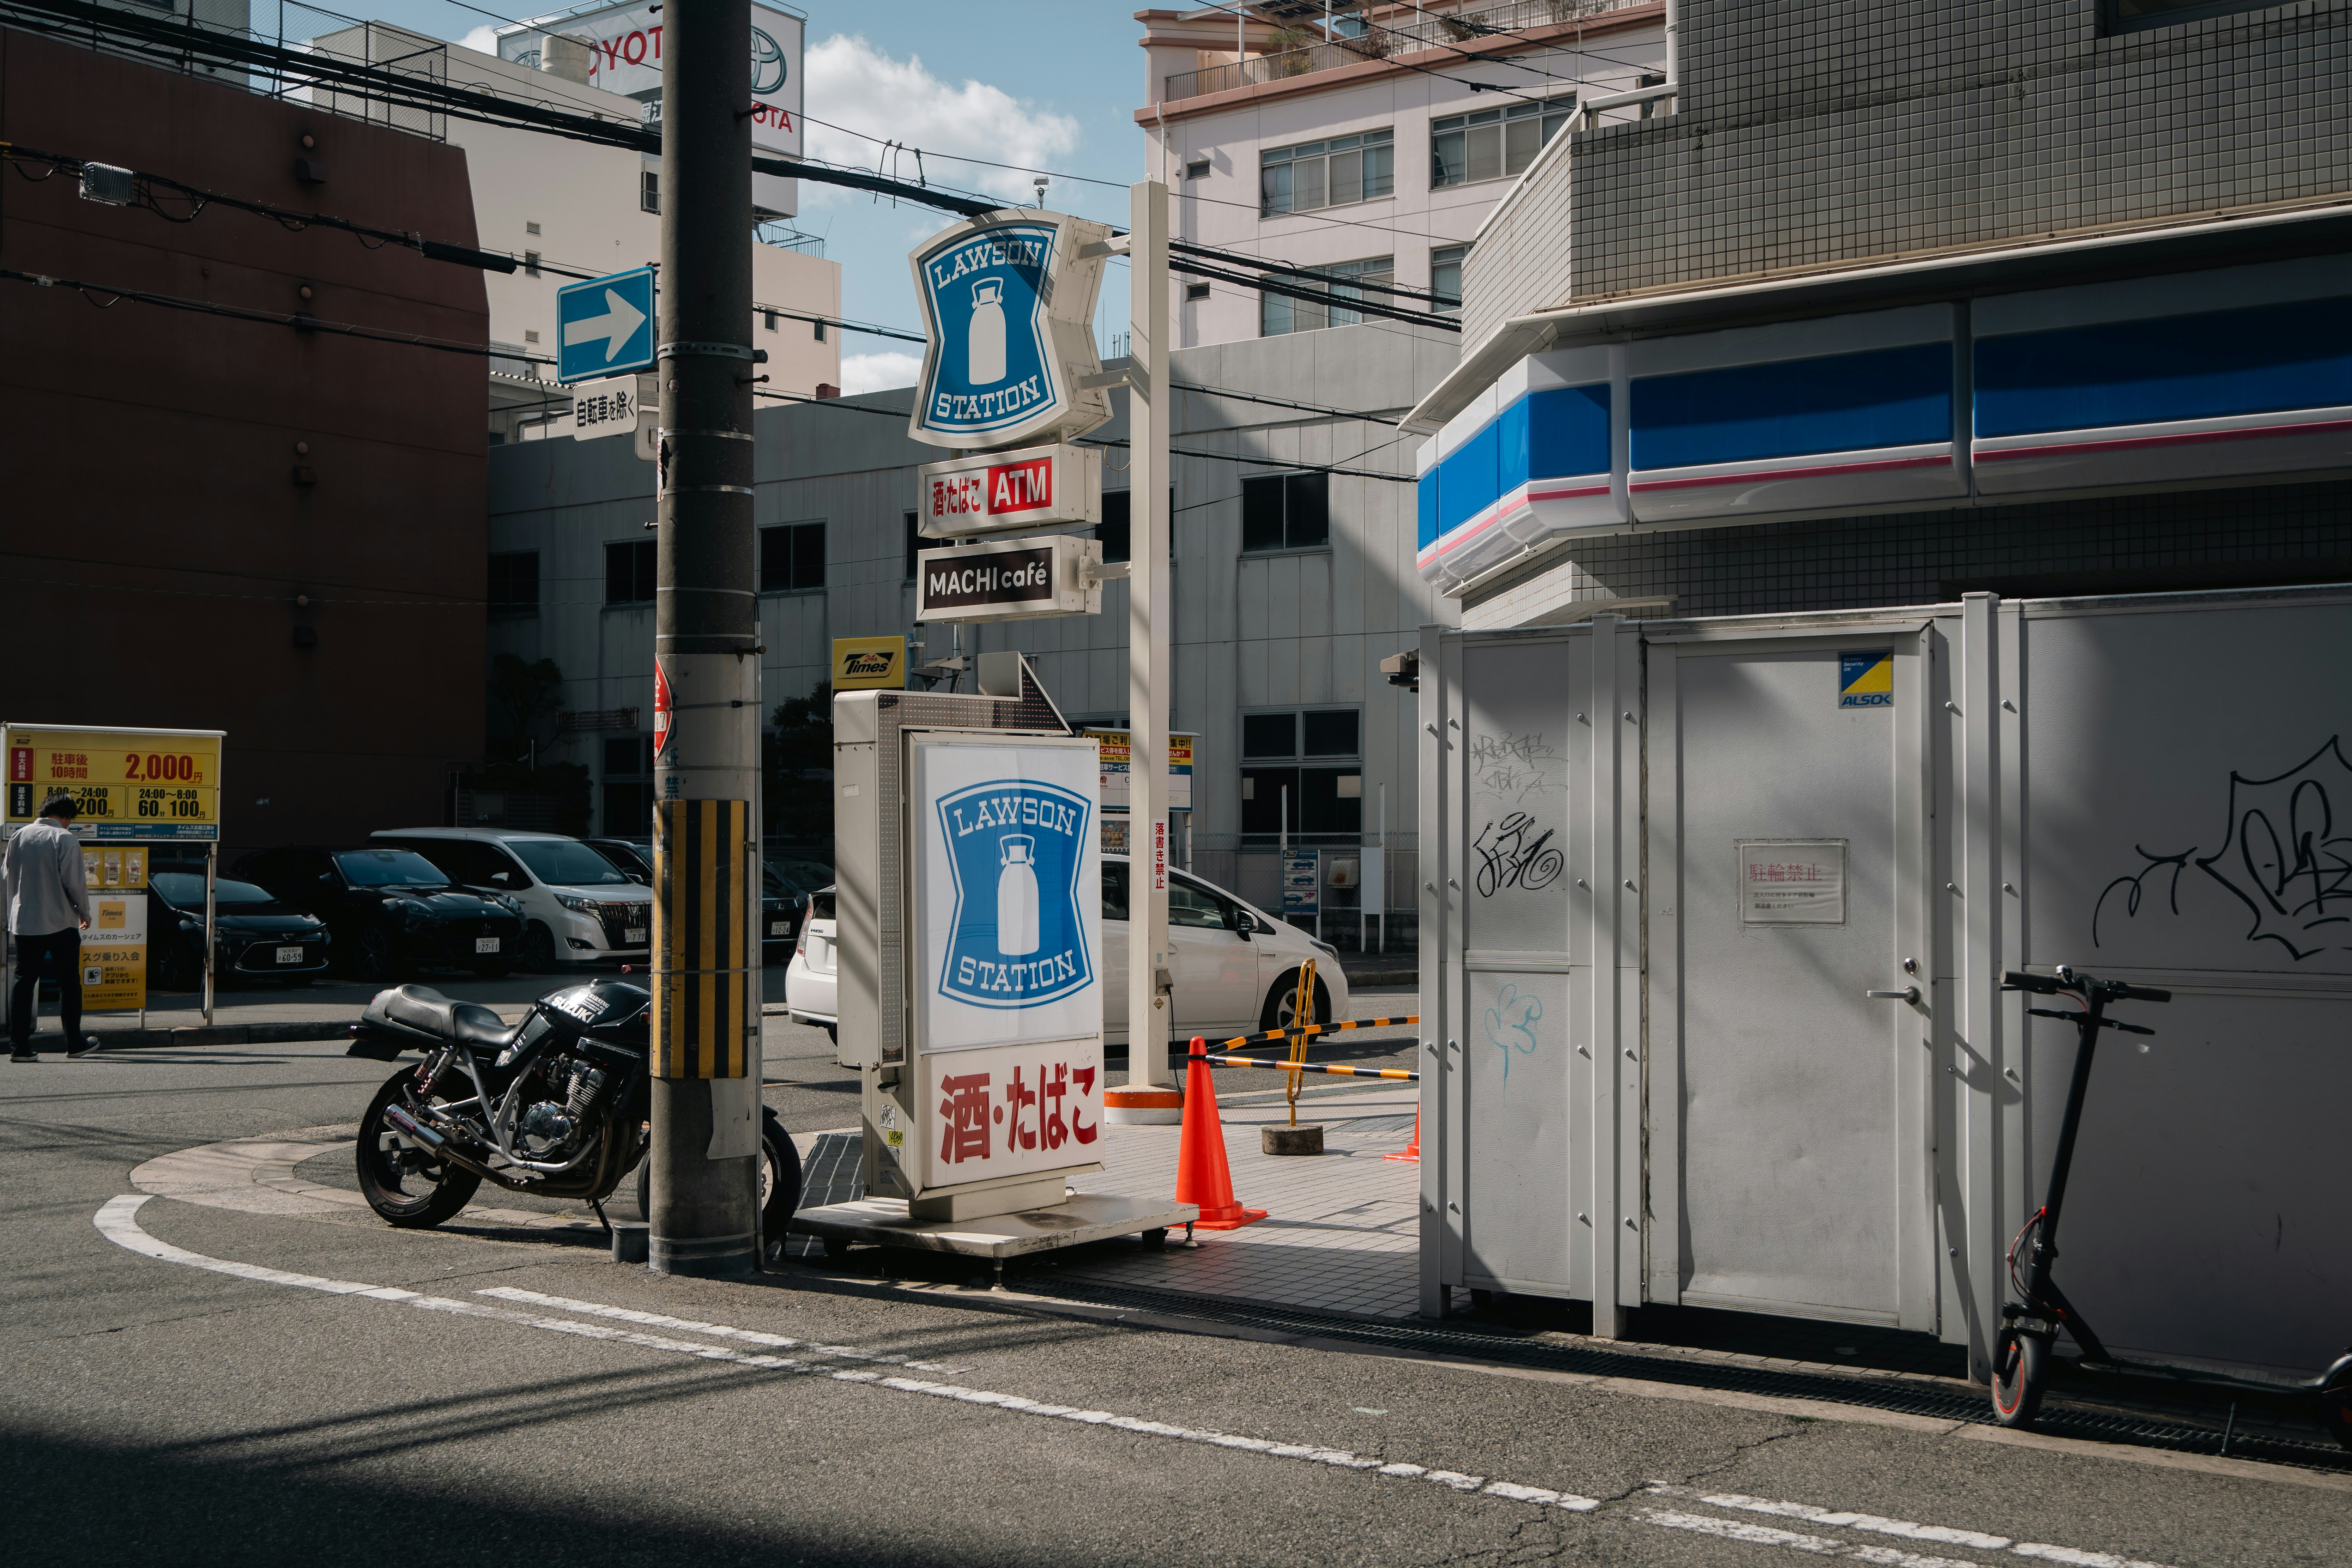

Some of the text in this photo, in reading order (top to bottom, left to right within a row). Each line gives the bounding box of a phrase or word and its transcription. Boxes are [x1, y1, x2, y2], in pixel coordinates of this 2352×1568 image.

[935, 240, 1042, 289] LAWSON
[577, 391, 634, 428] 自転車を除く
[936, 375, 1041, 419] STATION
[994, 466, 1046, 507] ATM
[930, 561, 1047, 596] MACHI café
[845, 659, 889, 674] Times
[1842, 694, 1891, 706] ALSOK
[51, 766, 87, 779] 10時間
[52, 753, 88, 765] 駐車後
[125, 753, 202, 782] 2,000円
[139, 800, 165, 817] 60分
[953, 797, 1076, 837] LAWSON
[1155, 822, 1165, 889] 落書き禁止
[1749, 863, 1822, 882] 駐輪禁止
[83, 951, 140, 962] スグ乗り入会
[282, 953, 301, 961] 60-59
[958, 949, 1076, 992] STATION
[551, 996, 595, 1024] SUZUKI
[939, 1061, 1098, 1164] 酒・たばこ
